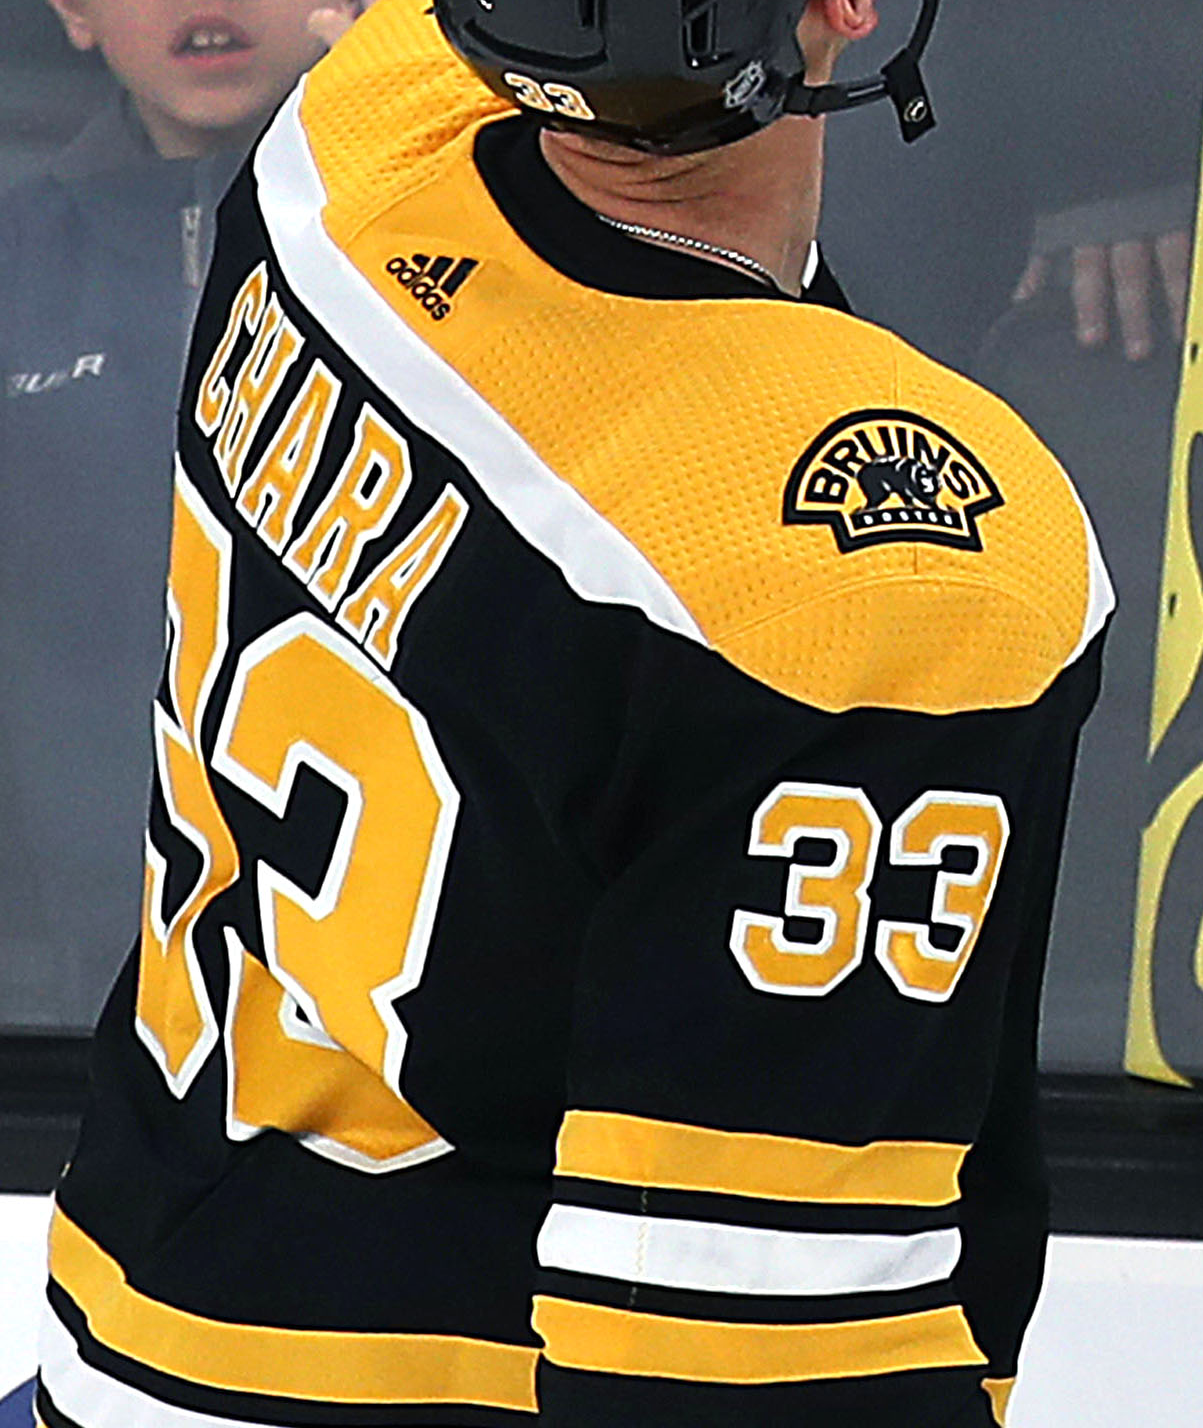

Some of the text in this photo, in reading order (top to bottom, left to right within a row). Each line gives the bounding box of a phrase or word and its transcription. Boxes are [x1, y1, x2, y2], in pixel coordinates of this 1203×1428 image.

[503, 71, 597, 121] 33
[386, 253, 452, 321] adidas
[194, 260, 470, 672] CHARA
[803, 426, 984, 504] BRUINS
[730, 782, 1010, 1003] 33
